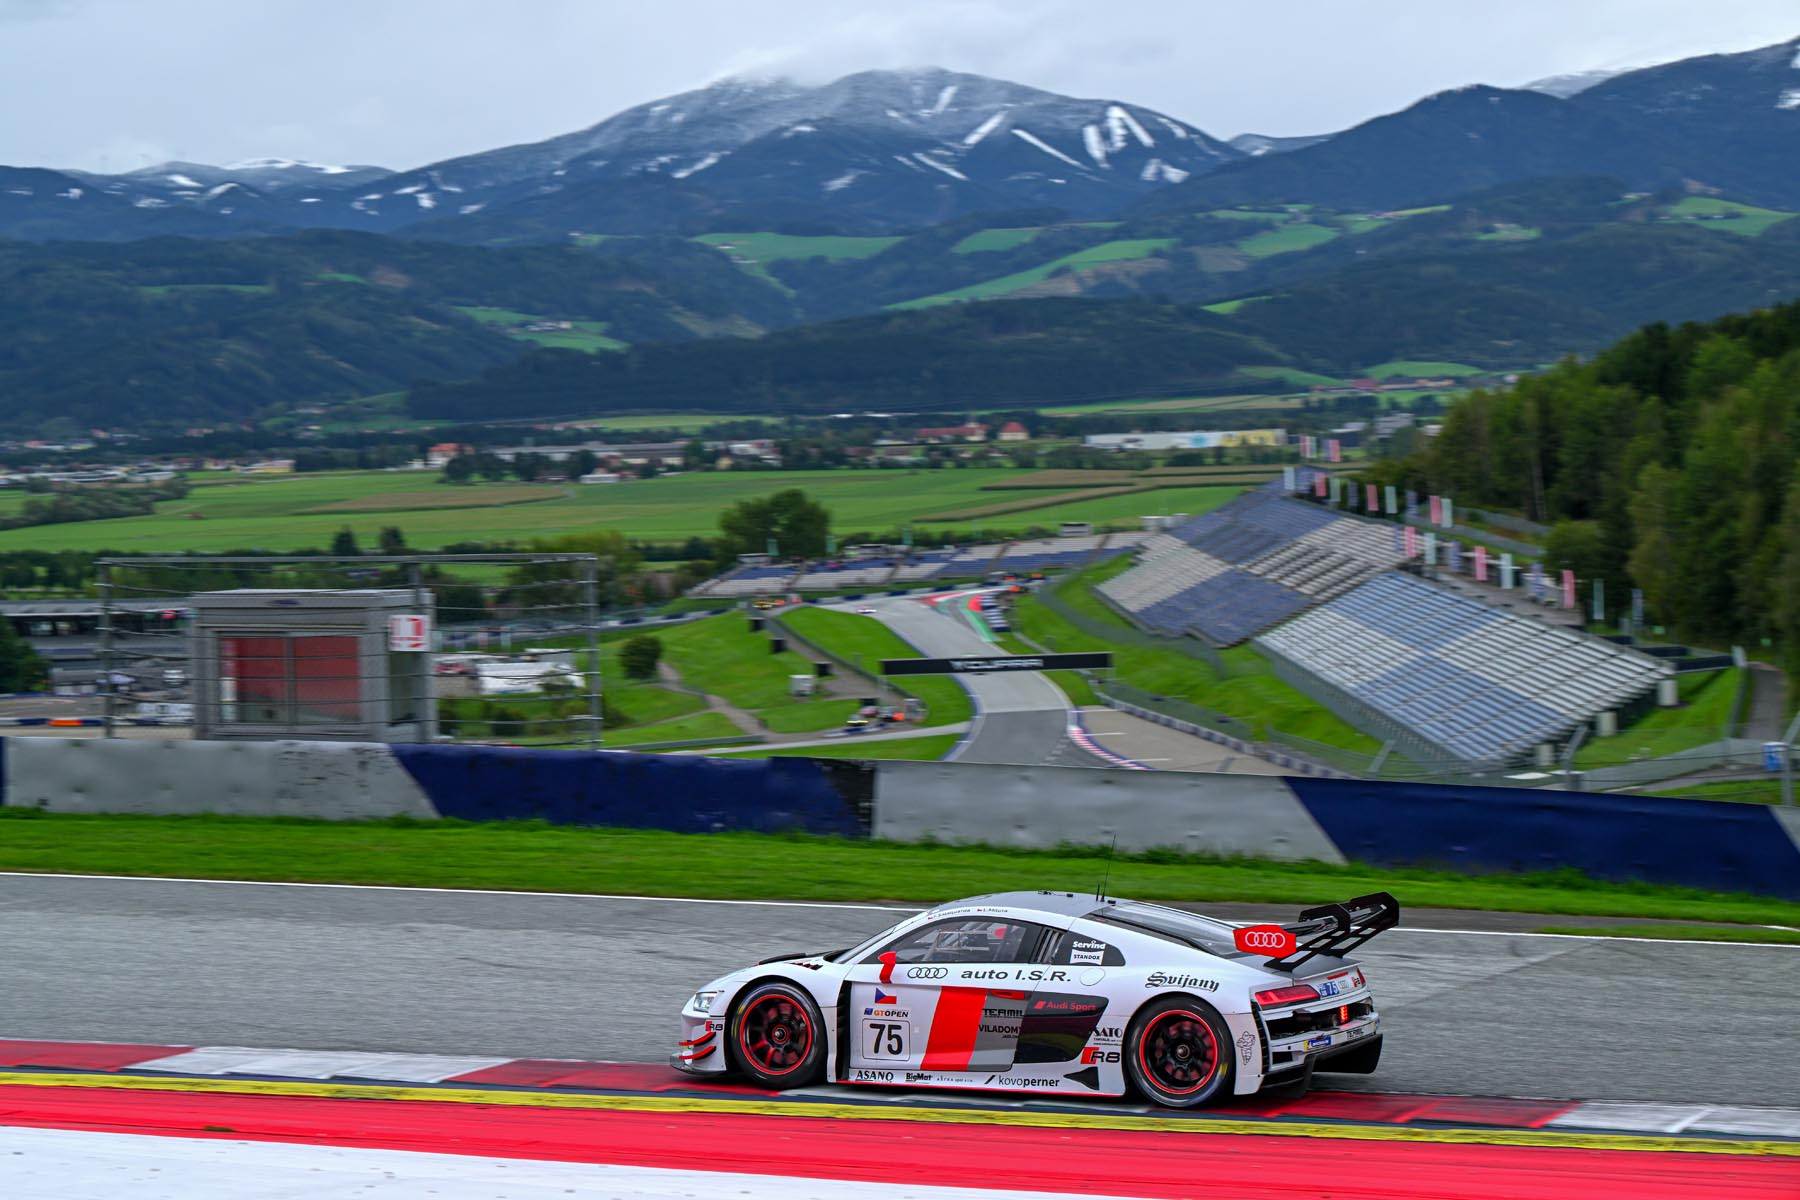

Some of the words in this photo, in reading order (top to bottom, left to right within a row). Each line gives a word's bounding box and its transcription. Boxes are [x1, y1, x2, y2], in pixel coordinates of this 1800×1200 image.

[1072, 940, 1106, 950] Servind
[961, 969, 1008, 980] auto
[1015, 970, 1071, 982] I.S.R.
[1145, 971, 1220, 993] Svijany
[1046, 1001, 1068, 1009] Audi
[1070, 1002, 1097, 1011] Sport
[869, 1023, 903, 1055] 75
[1090, 1051, 1121, 1063] R8
[906, 1072, 933, 1082] BigMat
[998, 1074, 1060, 1088] kovoperner
